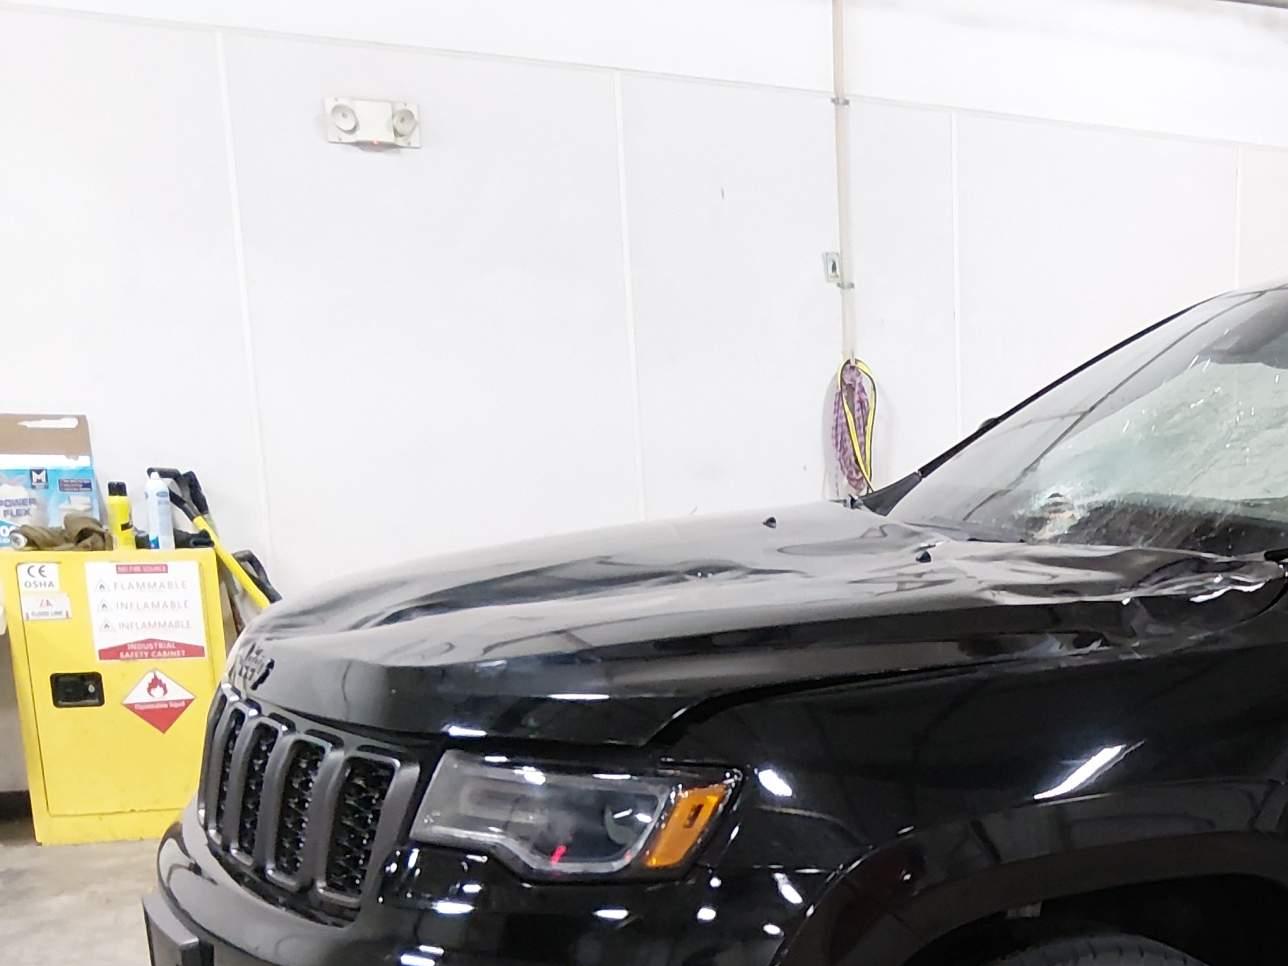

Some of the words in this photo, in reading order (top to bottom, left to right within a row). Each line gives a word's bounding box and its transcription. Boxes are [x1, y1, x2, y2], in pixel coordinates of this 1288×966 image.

[24, 580, 55, 589] OSHA
[113, 581, 187, 590] FLAMMABLE
[116, 600, 189, 609] INFLAMABLE
[118, 620, 191, 630] INFLAMMABLE
[127, 642, 176, 650] INDUSTRIAL
[151, 650, 186, 658] CABINET
